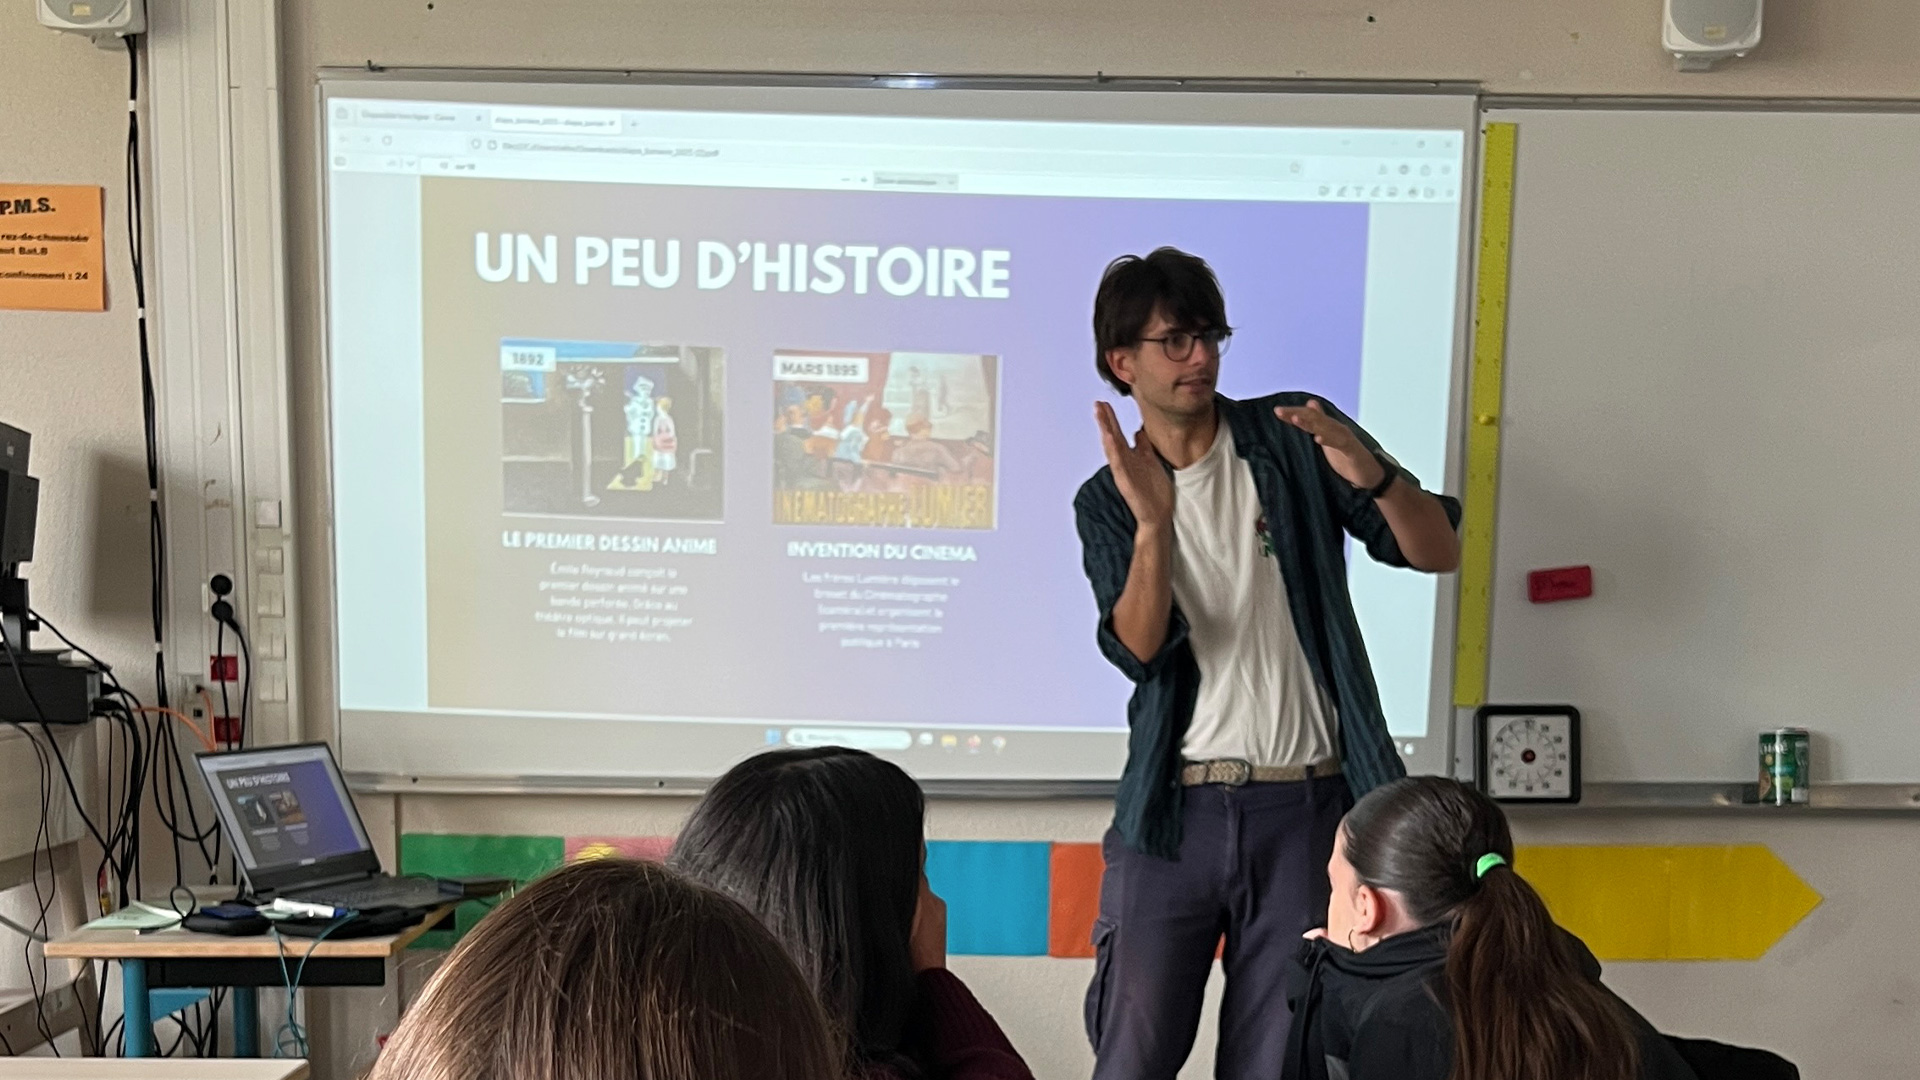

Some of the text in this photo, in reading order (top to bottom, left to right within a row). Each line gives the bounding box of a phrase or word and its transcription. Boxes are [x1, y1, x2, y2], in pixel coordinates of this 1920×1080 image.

[475, 232, 1011, 299] UN PEU D'HISTOIRE
[75, 272, 88, 280] 24
[511, 352, 544, 366] 1892
[780, 361, 859, 377] MARS 1895
[502, 530, 717, 554] LE PREMIER DESSIN ANIME
[787, 541, 978, 562] INVENTION DU CINEMA
